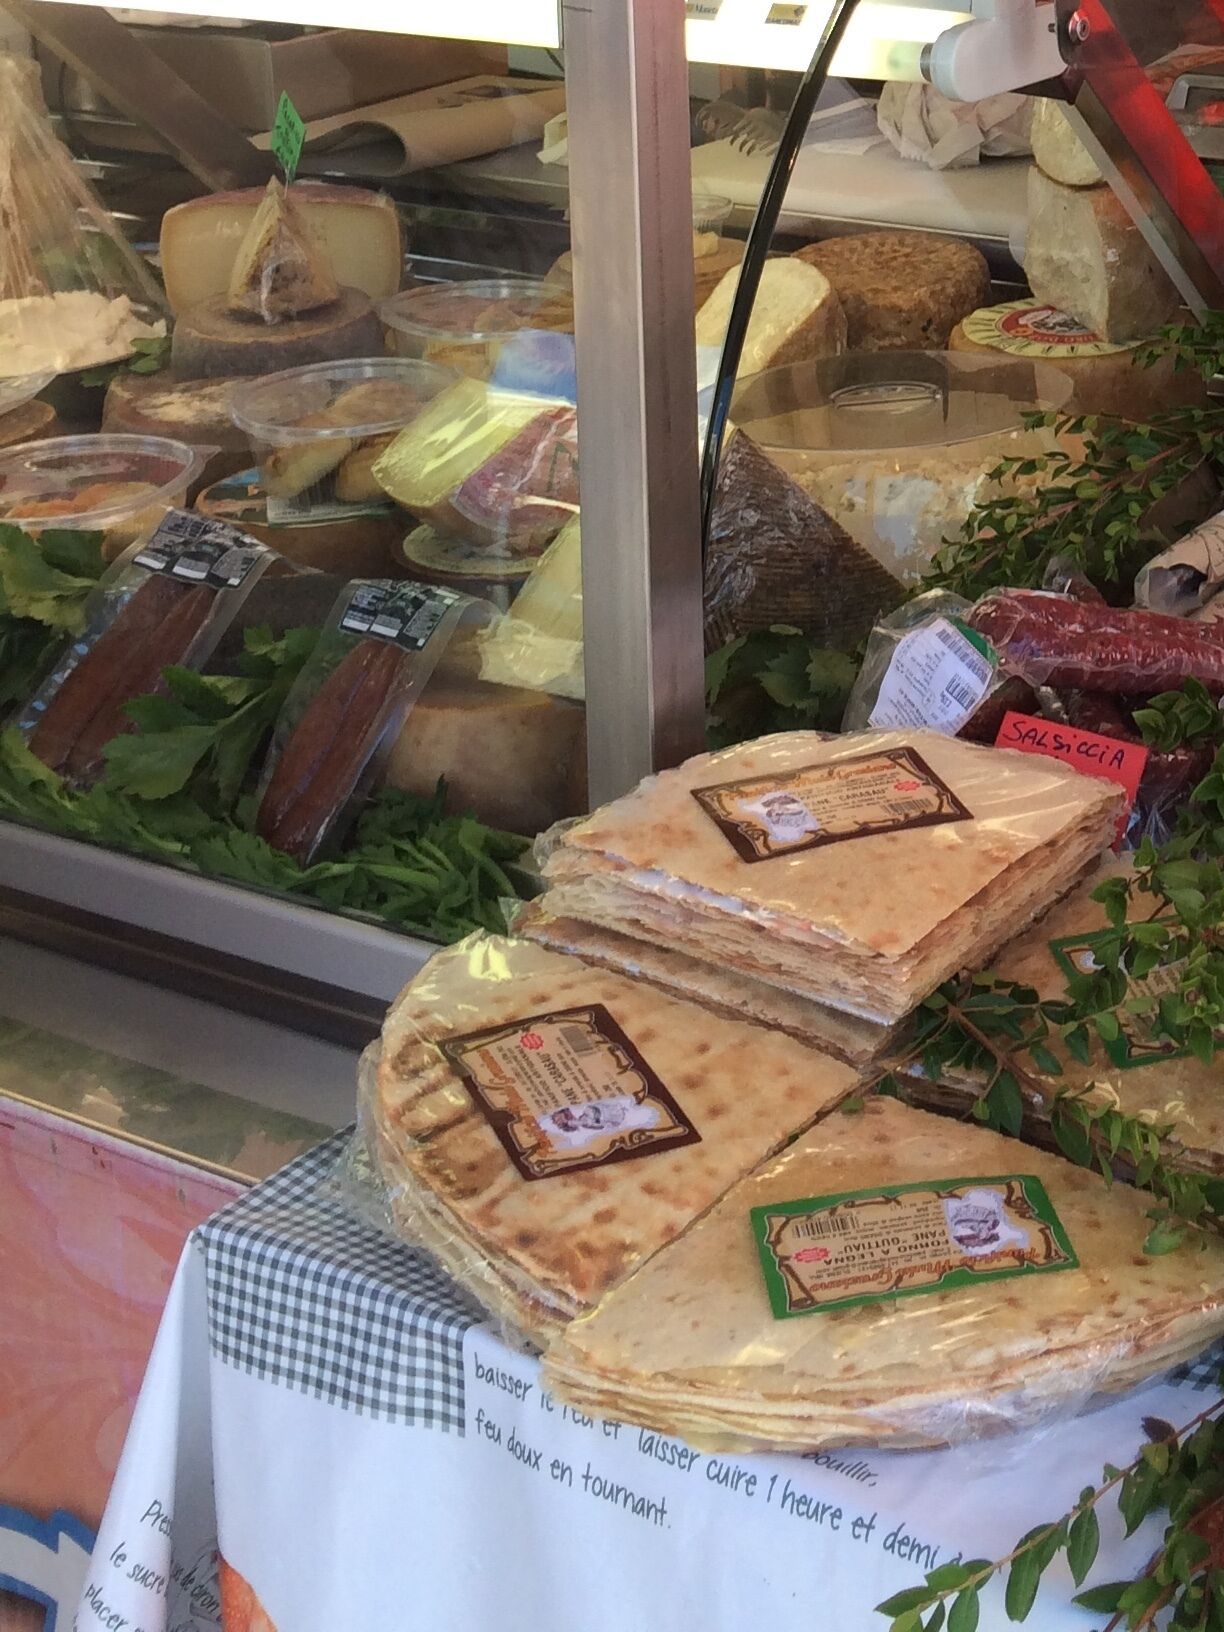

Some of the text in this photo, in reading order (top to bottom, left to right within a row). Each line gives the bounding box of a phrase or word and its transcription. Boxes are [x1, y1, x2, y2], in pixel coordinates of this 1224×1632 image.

[474, 1352, 533, 1402] baisser
[638, 1428, 701, 1473] laisser
[707, 1459, 757, 1498] cuire
[781, 1479, 843, 1531] heure
[852, 1512, 878, 1543] et
[883, 1522, 941, 1570] demi
[475, 1408, 671, 1529] feu doux en tournant.
[110, 1541, 127, 1568] le
